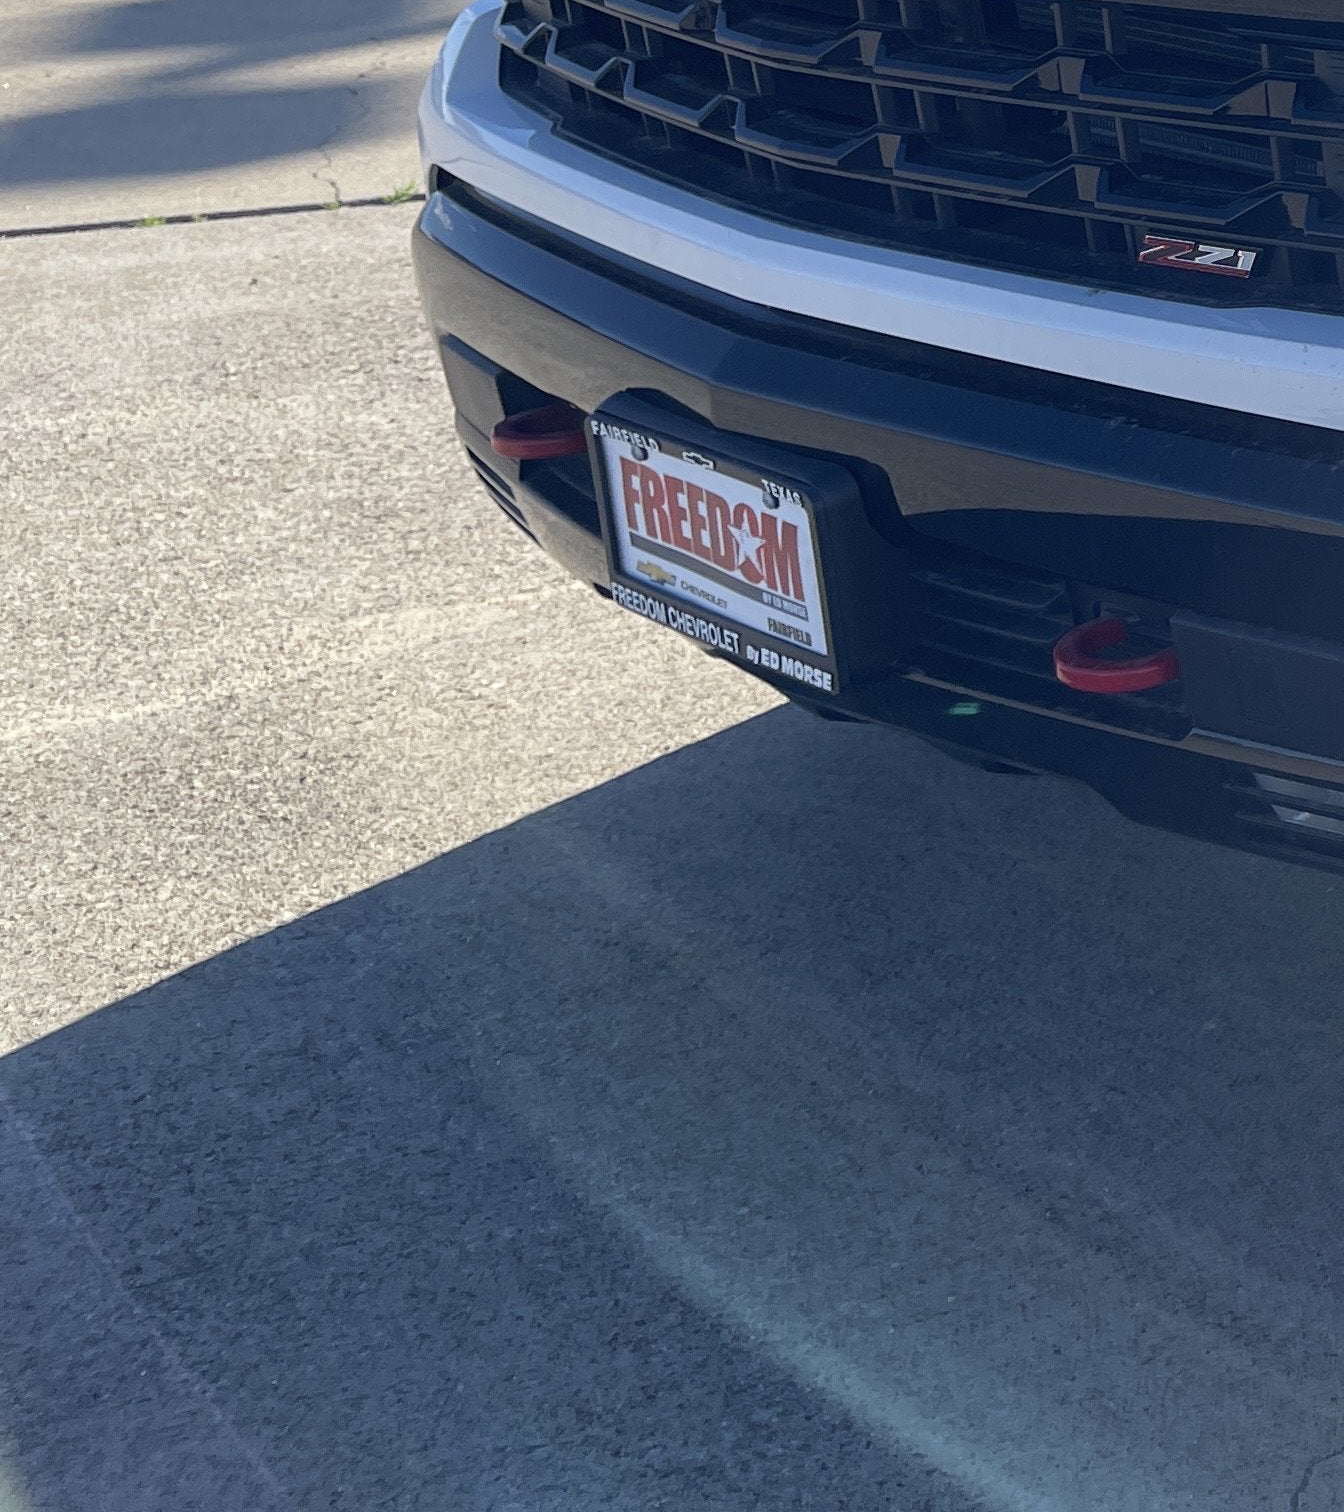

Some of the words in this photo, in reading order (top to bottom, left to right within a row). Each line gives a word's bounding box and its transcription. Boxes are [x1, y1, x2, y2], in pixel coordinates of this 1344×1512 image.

[1138, 234, 1257, 279] Z71
[591, 420, 660, 453] FAIRFIELD
[761, 478, 803, 507] TEXAS
[619, 456, 806, 603] FREEDOM
[611, 582, 668, 624] FREEDOM
[668, 606, 739, 654] CHEVROLET
[760, 647, 780, 671] ED
[781, 655, 833, 692] MORSE
